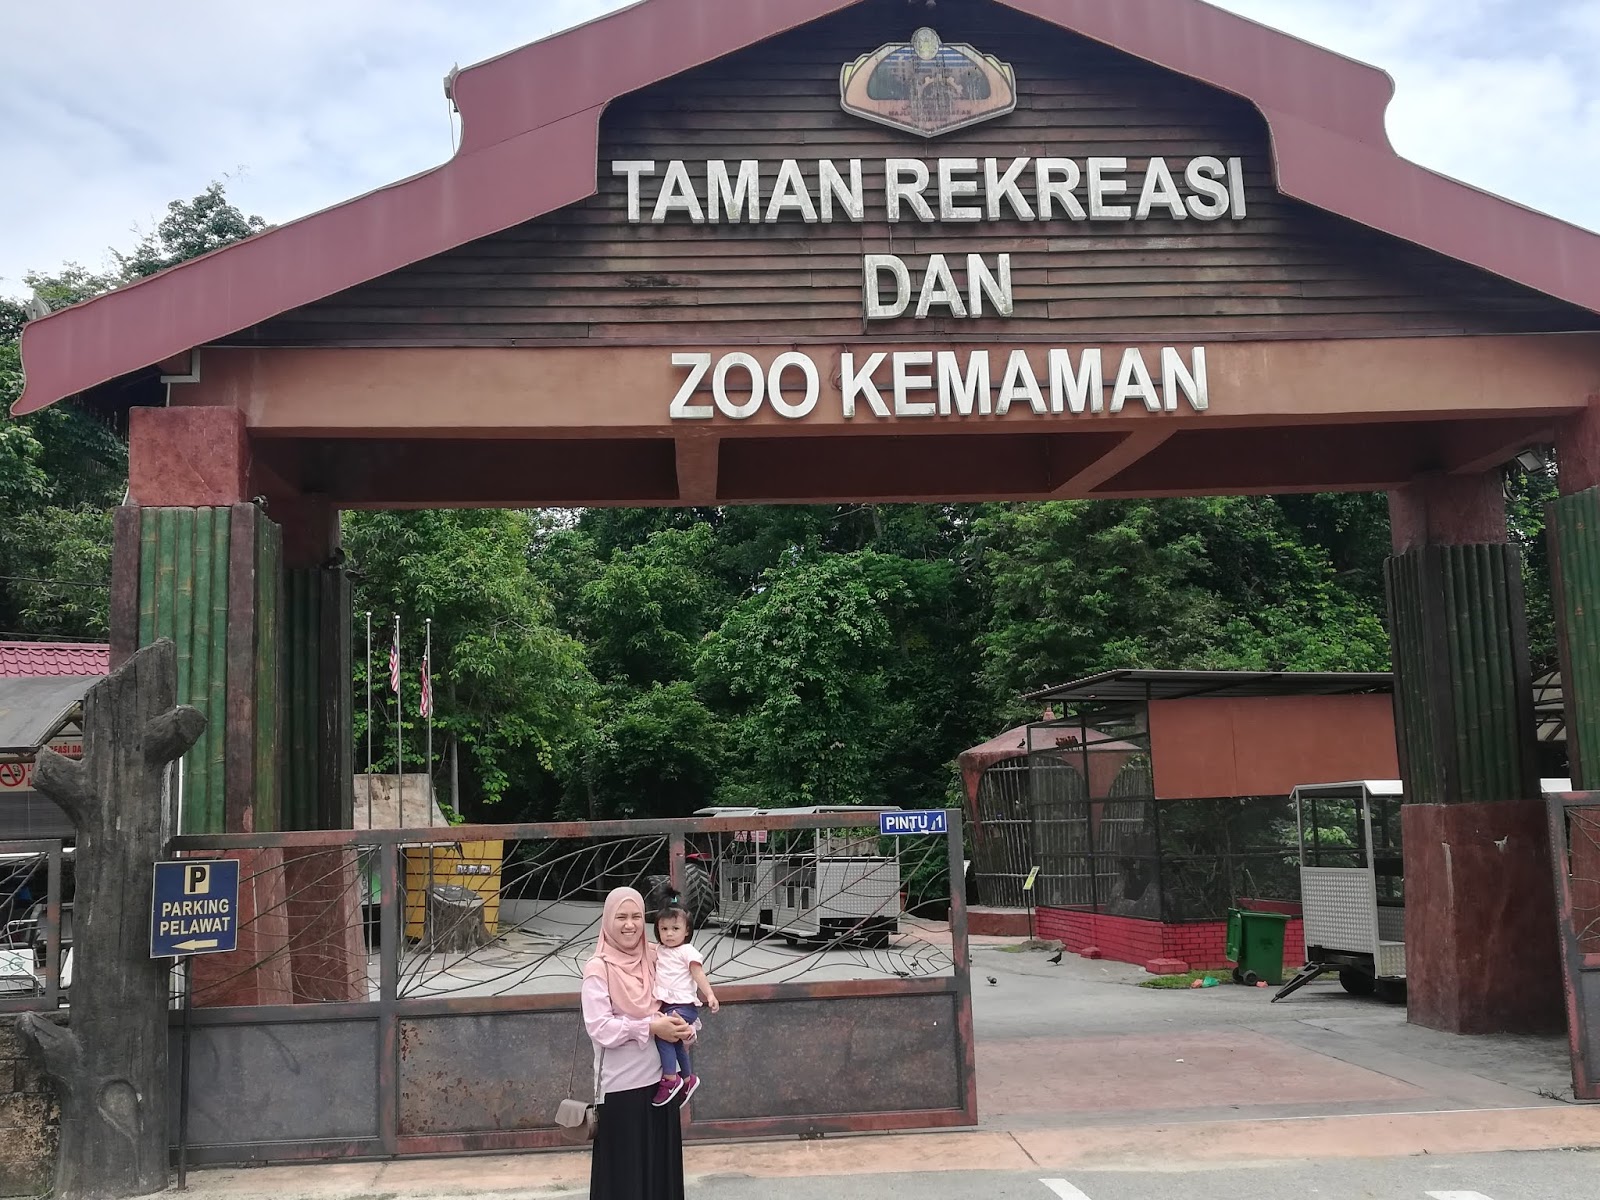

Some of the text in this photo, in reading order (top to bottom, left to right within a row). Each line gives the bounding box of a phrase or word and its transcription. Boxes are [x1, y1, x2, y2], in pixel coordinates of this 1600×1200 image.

[611, 156, 1247, 224] TAMAN REKREASI
[864, 253, 1013, 321] DAN
[669, 346, 1209, 419] ZOO KEMAMAN
[885, 814, 943, 831] PINTU 1
[189, 866, 207, 893] P
[162, 898, 229, 918] PARKING
[159, 916, 231, 937] PELAWAT
